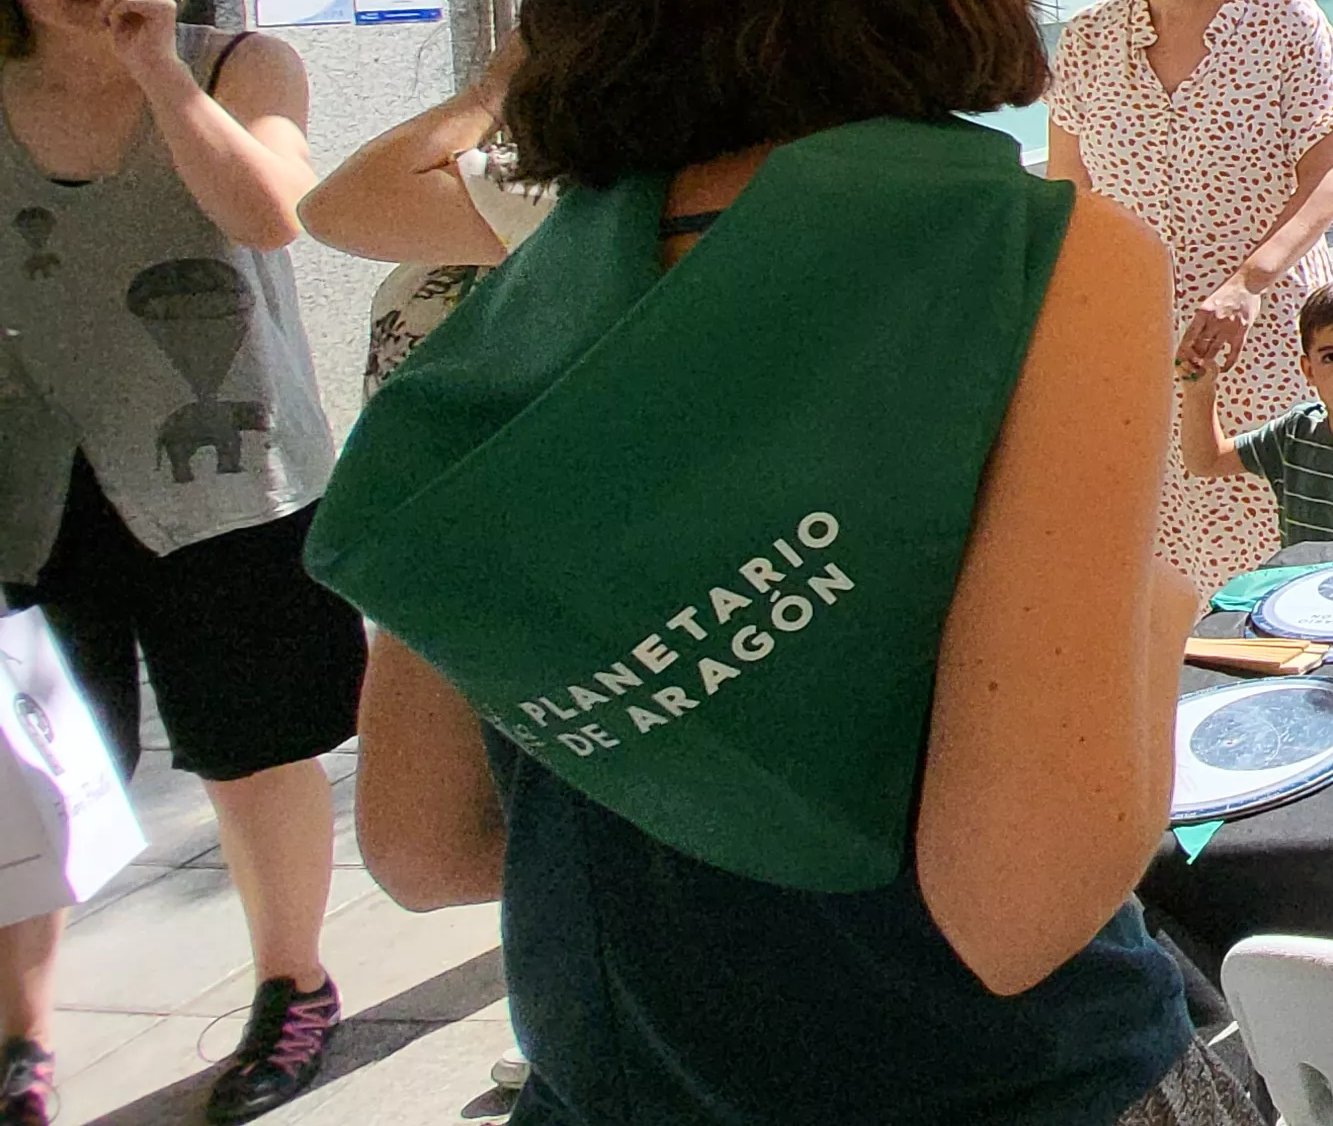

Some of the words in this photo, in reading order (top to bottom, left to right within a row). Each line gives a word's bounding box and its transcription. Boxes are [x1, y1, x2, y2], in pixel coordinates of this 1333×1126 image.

[518, 511, 839, 728] PLANETARIO
[556, 722, 621, 757] DE
[626, 562, 856, 734] ARAGÓN
